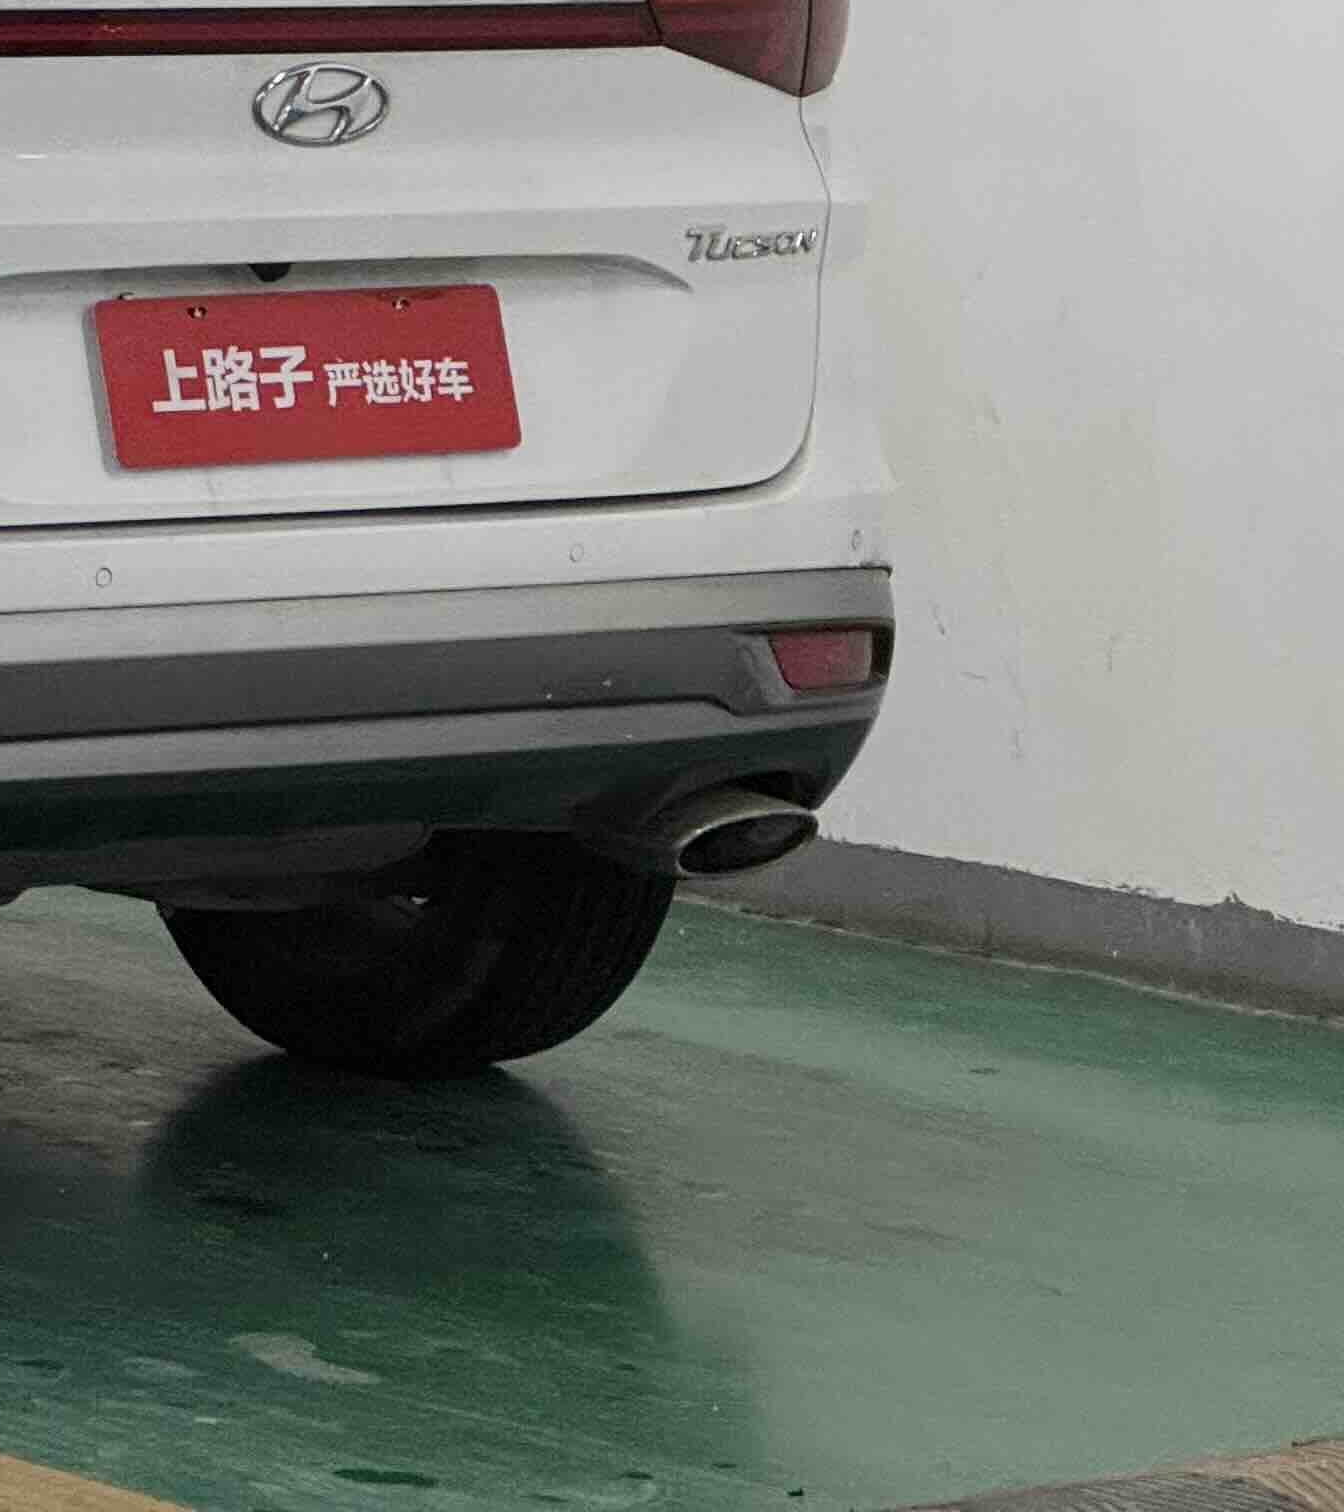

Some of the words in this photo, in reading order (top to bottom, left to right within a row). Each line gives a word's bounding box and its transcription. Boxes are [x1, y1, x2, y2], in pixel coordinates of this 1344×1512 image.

[152, 345, 313, 413] 上路子
[323, 356, 474, 407] 严选好车
